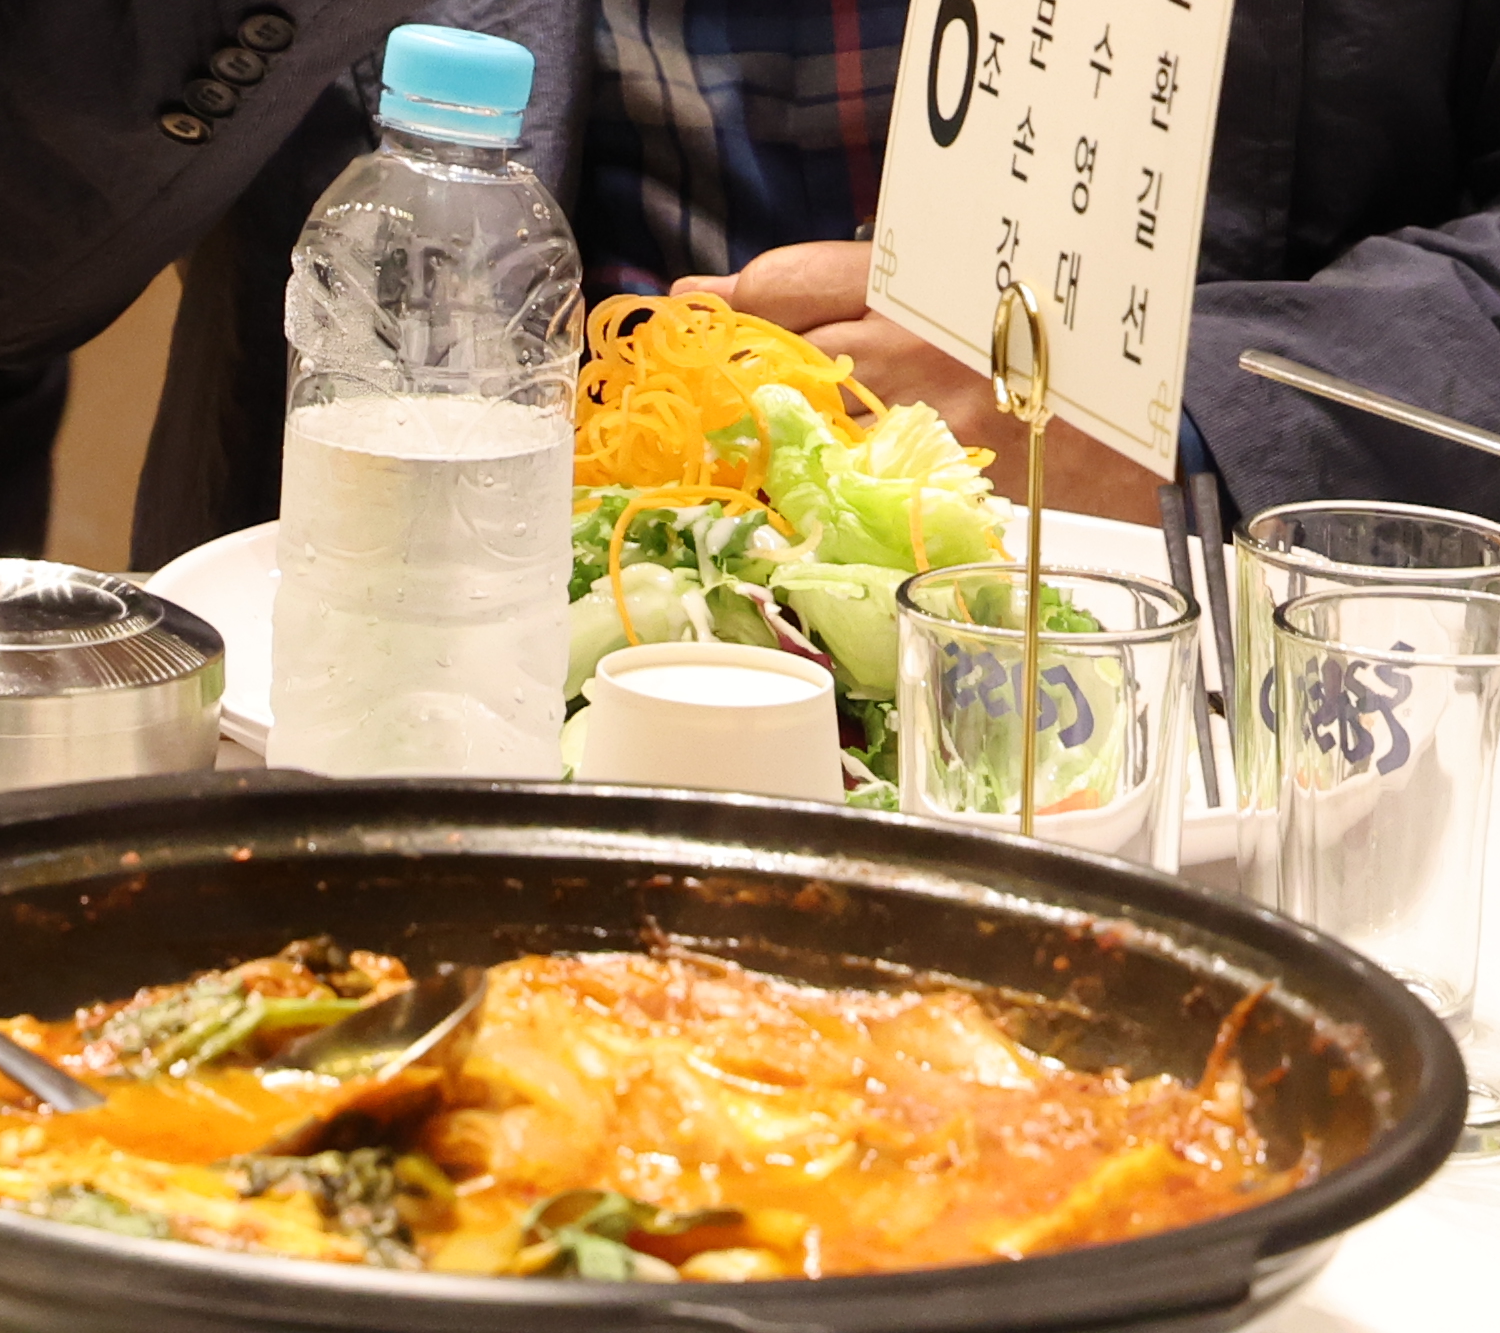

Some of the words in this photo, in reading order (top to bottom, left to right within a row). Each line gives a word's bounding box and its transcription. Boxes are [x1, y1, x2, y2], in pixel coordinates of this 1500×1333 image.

[1090, 22, 1114, 99] 수
[1151, 51, 1180, 131] 환
[1011, 105, 1035, 183] 손
[1072, 136, 1098, 215] 영
[1136, 167, 1163, 251] 길
[996, 217, 1019, 293] 강
[1054, 251, 1081, 331] 대
[1122, 285, 1148, 365] 선
